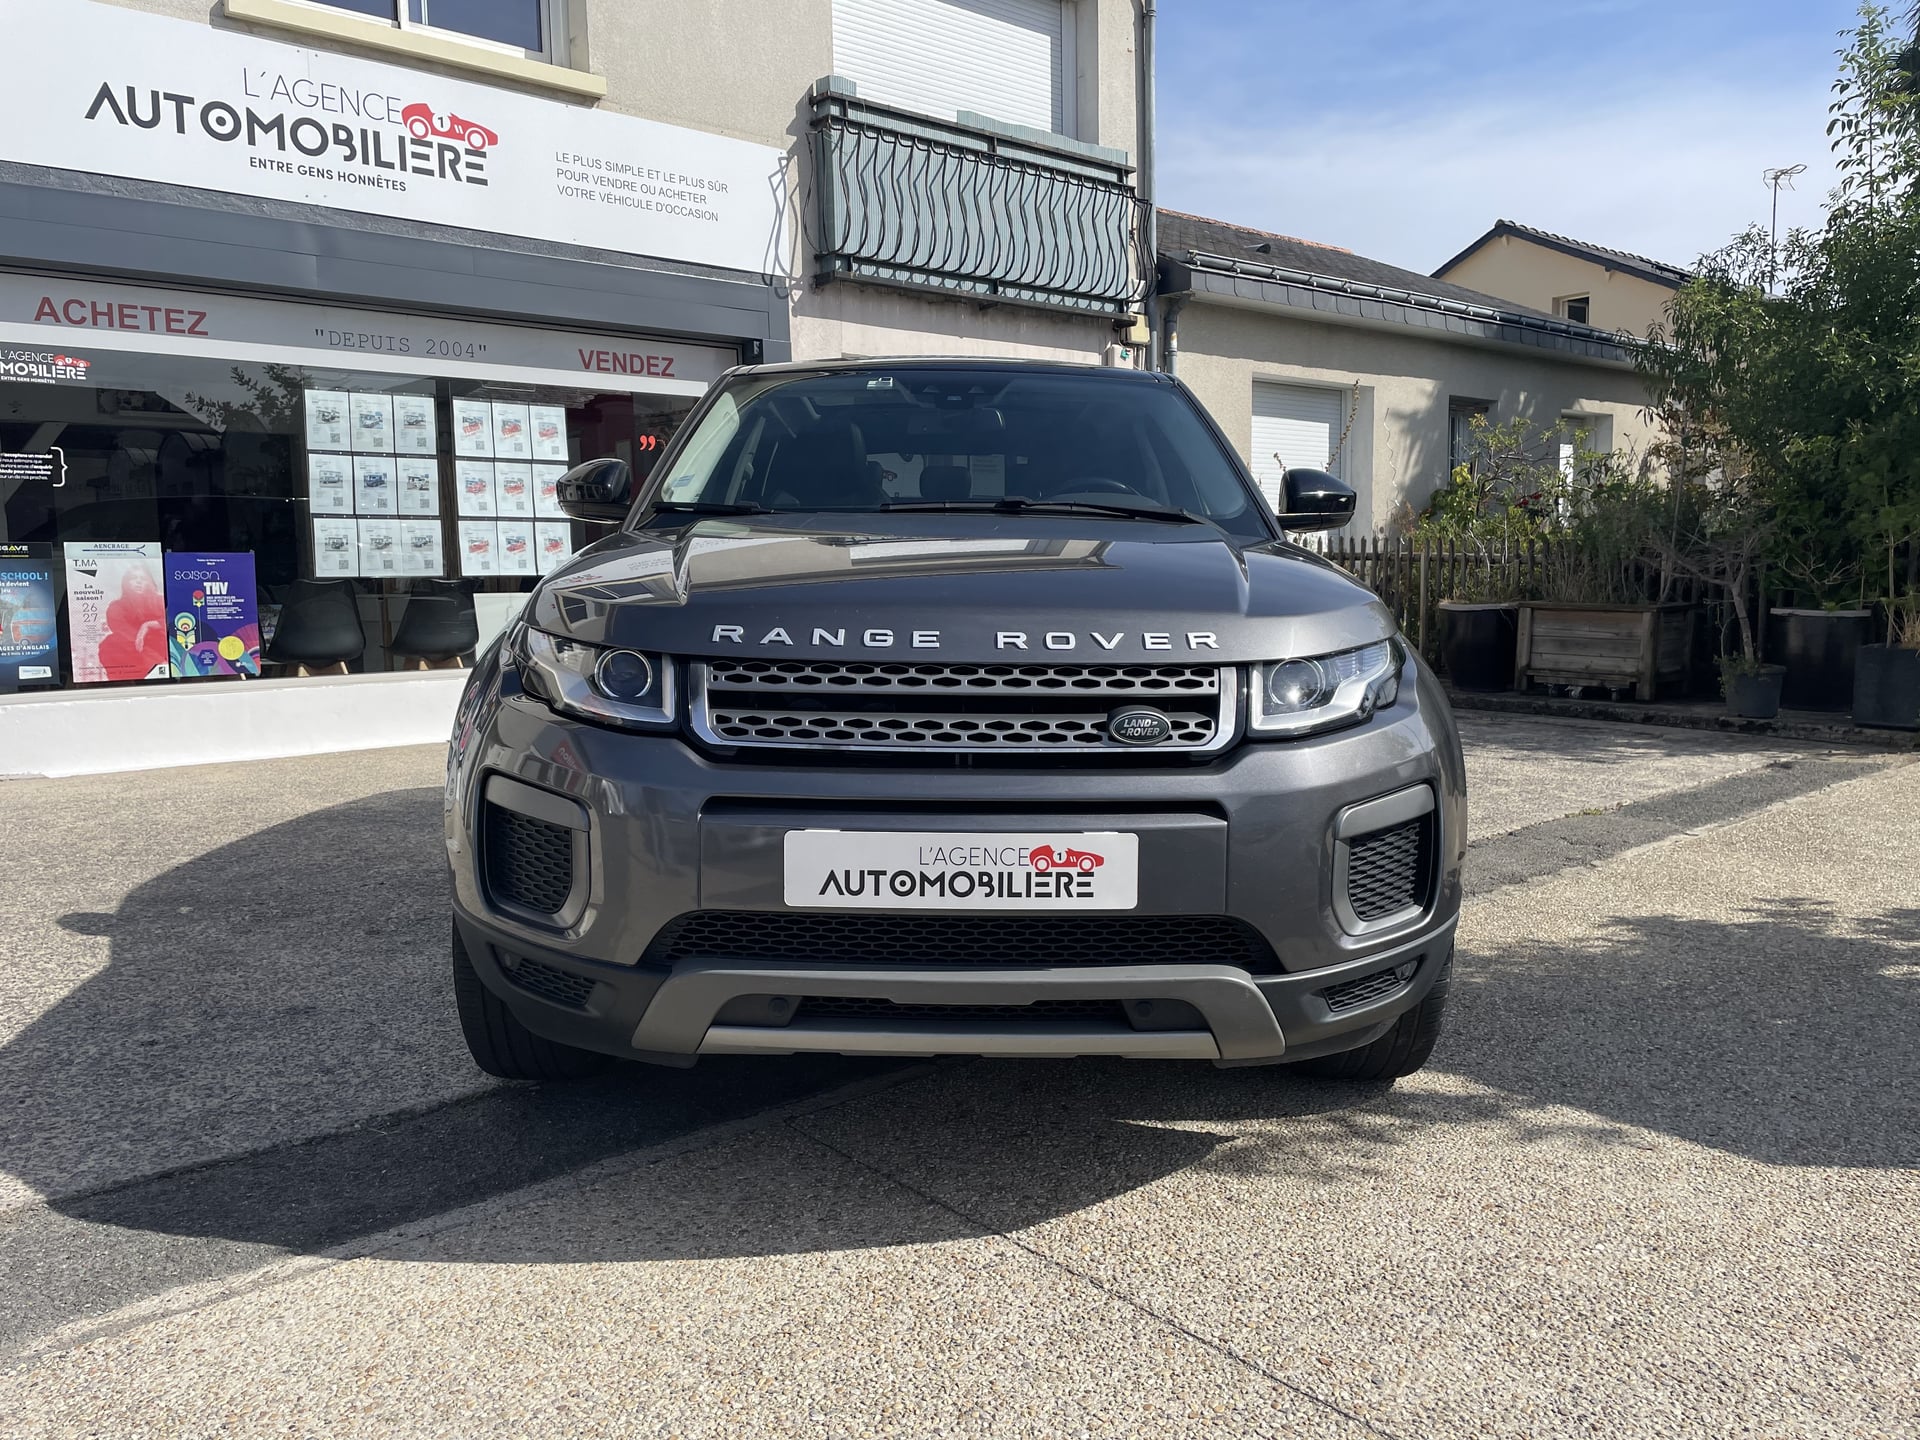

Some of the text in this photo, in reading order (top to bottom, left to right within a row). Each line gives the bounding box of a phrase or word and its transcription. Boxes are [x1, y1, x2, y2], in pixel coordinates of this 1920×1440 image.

[244, 67, 402, 125] L'AGENCE
[250, 157, 407, 192] ENTRE GENS HONNÊTES
[556, 152, 728, 193] LE PLUS SIMPLE ET LE PLUS SÛR
[556, 168, 707, 204] POUR VENDRE OU ACHETER
[557, 184, 719, 222] VOTRE VÉHICULE D'OCCASION
[34, 296, 209, 336] ACHETEZ
[0, 350, 54, 363] L'AGENCE
[315, 328, 487, 358] "DEPUIS 2004"
[578, 348, 675, 377] VENDEZ
[1, 572, 42, 580] SCHOOL
[203, 582, 228, 595] THV
[82, 602, 98, 612] 26
[82, 613, 98, 622] 27
[711, 625, 1219, 651] RANGE ROVER
[919, 846, 1030, 866] L'AGENCE
